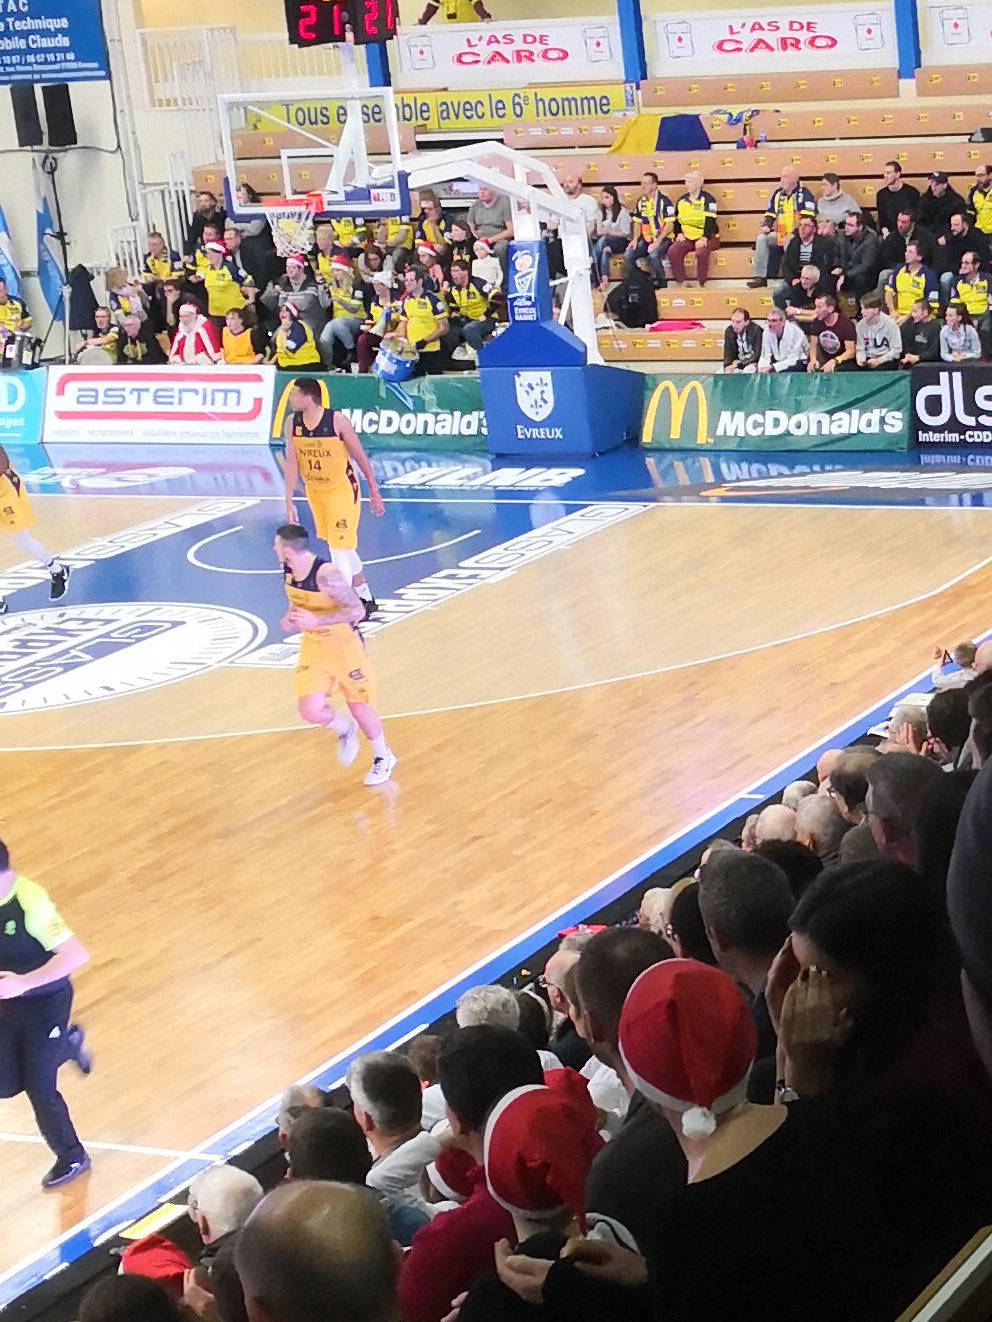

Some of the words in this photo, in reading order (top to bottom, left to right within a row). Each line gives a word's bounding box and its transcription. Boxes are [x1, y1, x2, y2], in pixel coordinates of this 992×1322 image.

[6, 16, 69, 33] Technique
[728, 20, 780, 35] L'AS
[789, 20, 818, 33] DE
[28, 33, 70, 49] Claude
[466, 33, 515, 48] L'AS
[522, 33, 549, 45] DE
[713, 34, 838, 55] CARO
[453, 47, 569, 66] CARO
[281, 103, 330, 126] Tous
[336, 96, 430, 125] eseble
[439, 99, 485, 121] avec
[488, 93, 506, 119] le
[534, 91, 611, 117] homme
[75, 387, 241, 407] asterim
[716, 407, 903, 437] McDonald's
[308, 459, 322, 472] 14
